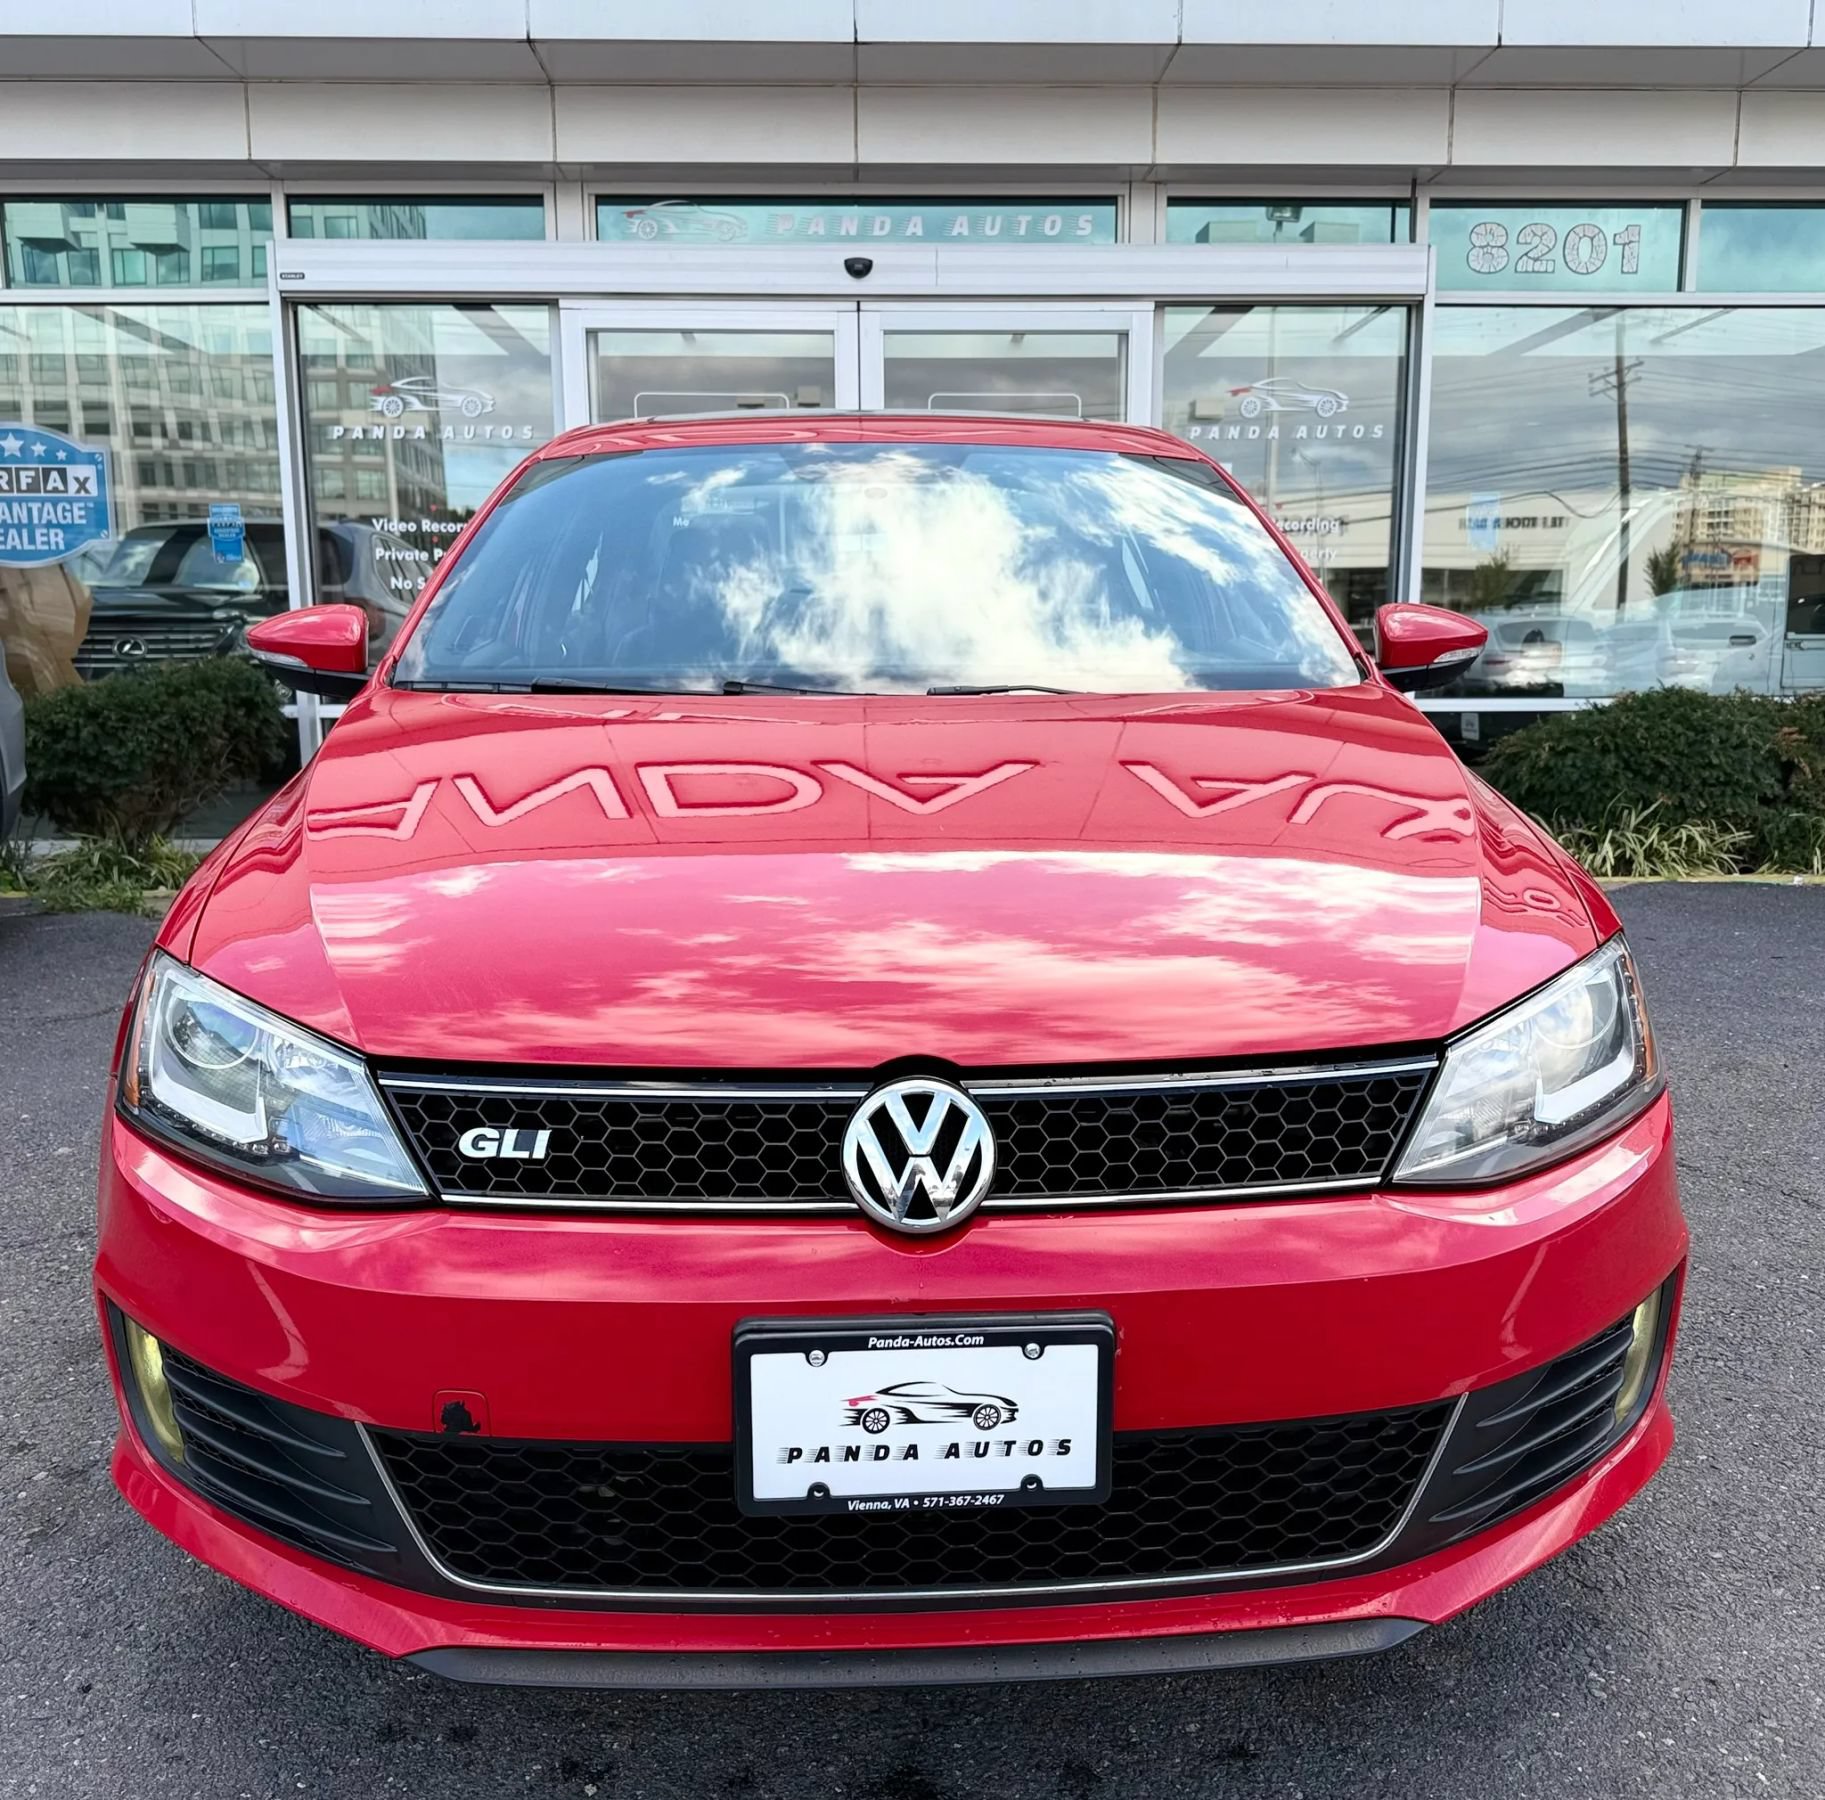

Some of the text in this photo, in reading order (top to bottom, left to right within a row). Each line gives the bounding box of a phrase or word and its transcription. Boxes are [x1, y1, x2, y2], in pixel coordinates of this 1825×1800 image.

[775, 213, 1093, 237] PANDA AUTOS
[1466, 221, 1641, 275] 8201
[332, 425, 534, 440] PANDA AUTOS
[1189, 424, 1384, 440] PANDA AUTOS
[371, 518, 417, 532] Video
[375, 547, 429, 561] Private
[390, 576, 413, 590] No
[458, 1127, 553, 1160] GLI
[867, 1334, 985, 1349] Panda-Autos.Com
[785, 1438, 1073, 1465] PANDA AUTOS
[847, 1494, 1005, 1511] Vienna, VA 571-367-2467
